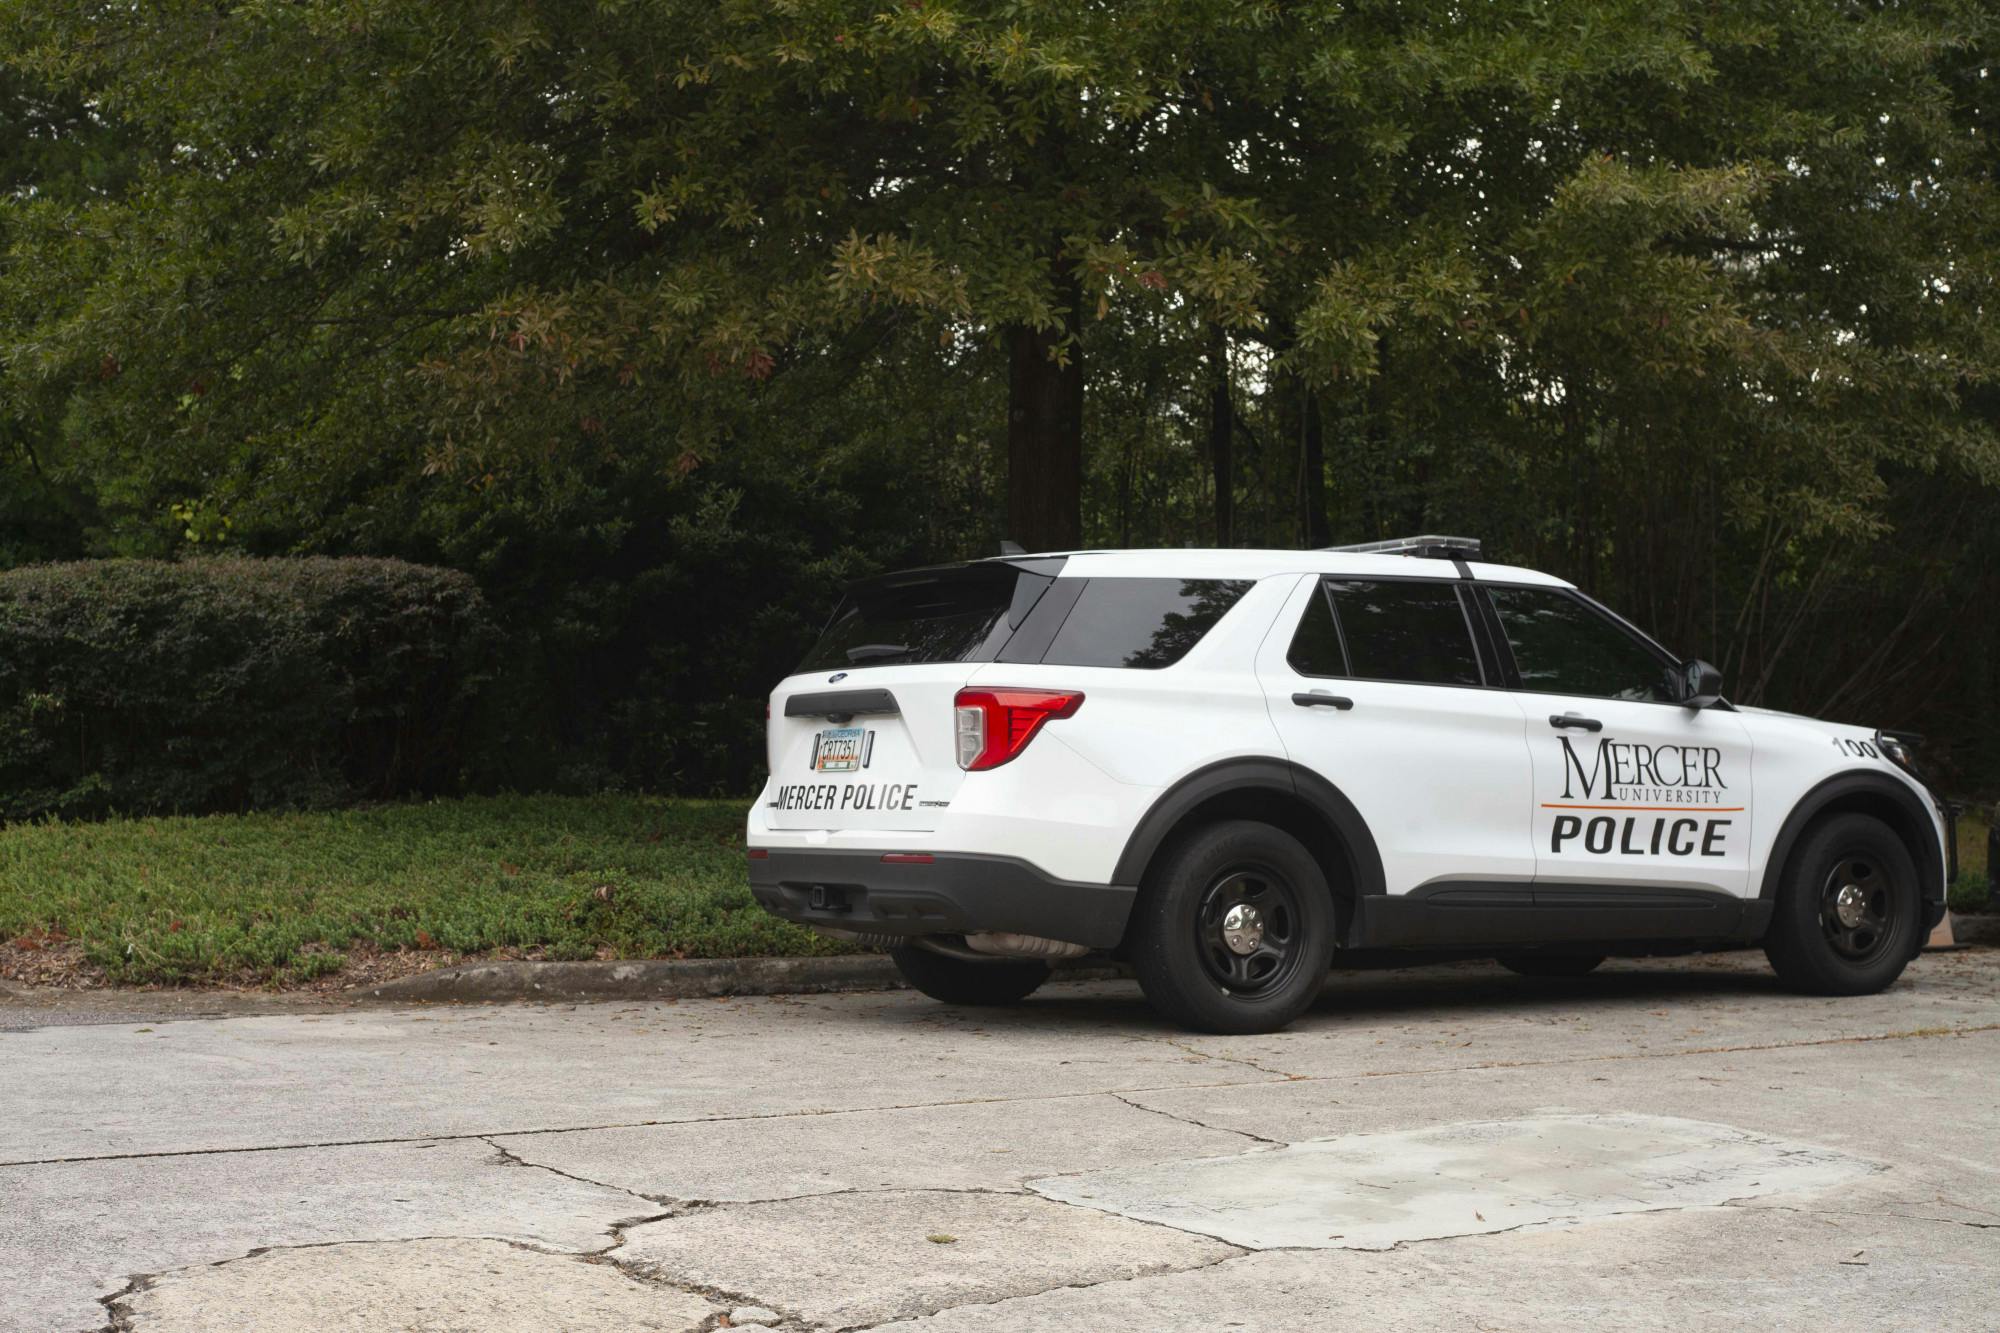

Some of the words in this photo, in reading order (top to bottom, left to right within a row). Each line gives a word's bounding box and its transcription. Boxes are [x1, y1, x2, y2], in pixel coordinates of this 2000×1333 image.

[1832, 737, 1878, 759] 100
[1556, 736, 1728, 800] MERCER
[777, 785, 837, 810] MERCER
[840, 784, 918, 810] POLICE
[1619, 788, 1722, 803] UNIVERSITY
[1551, 815, 1732, 857] POLICE
